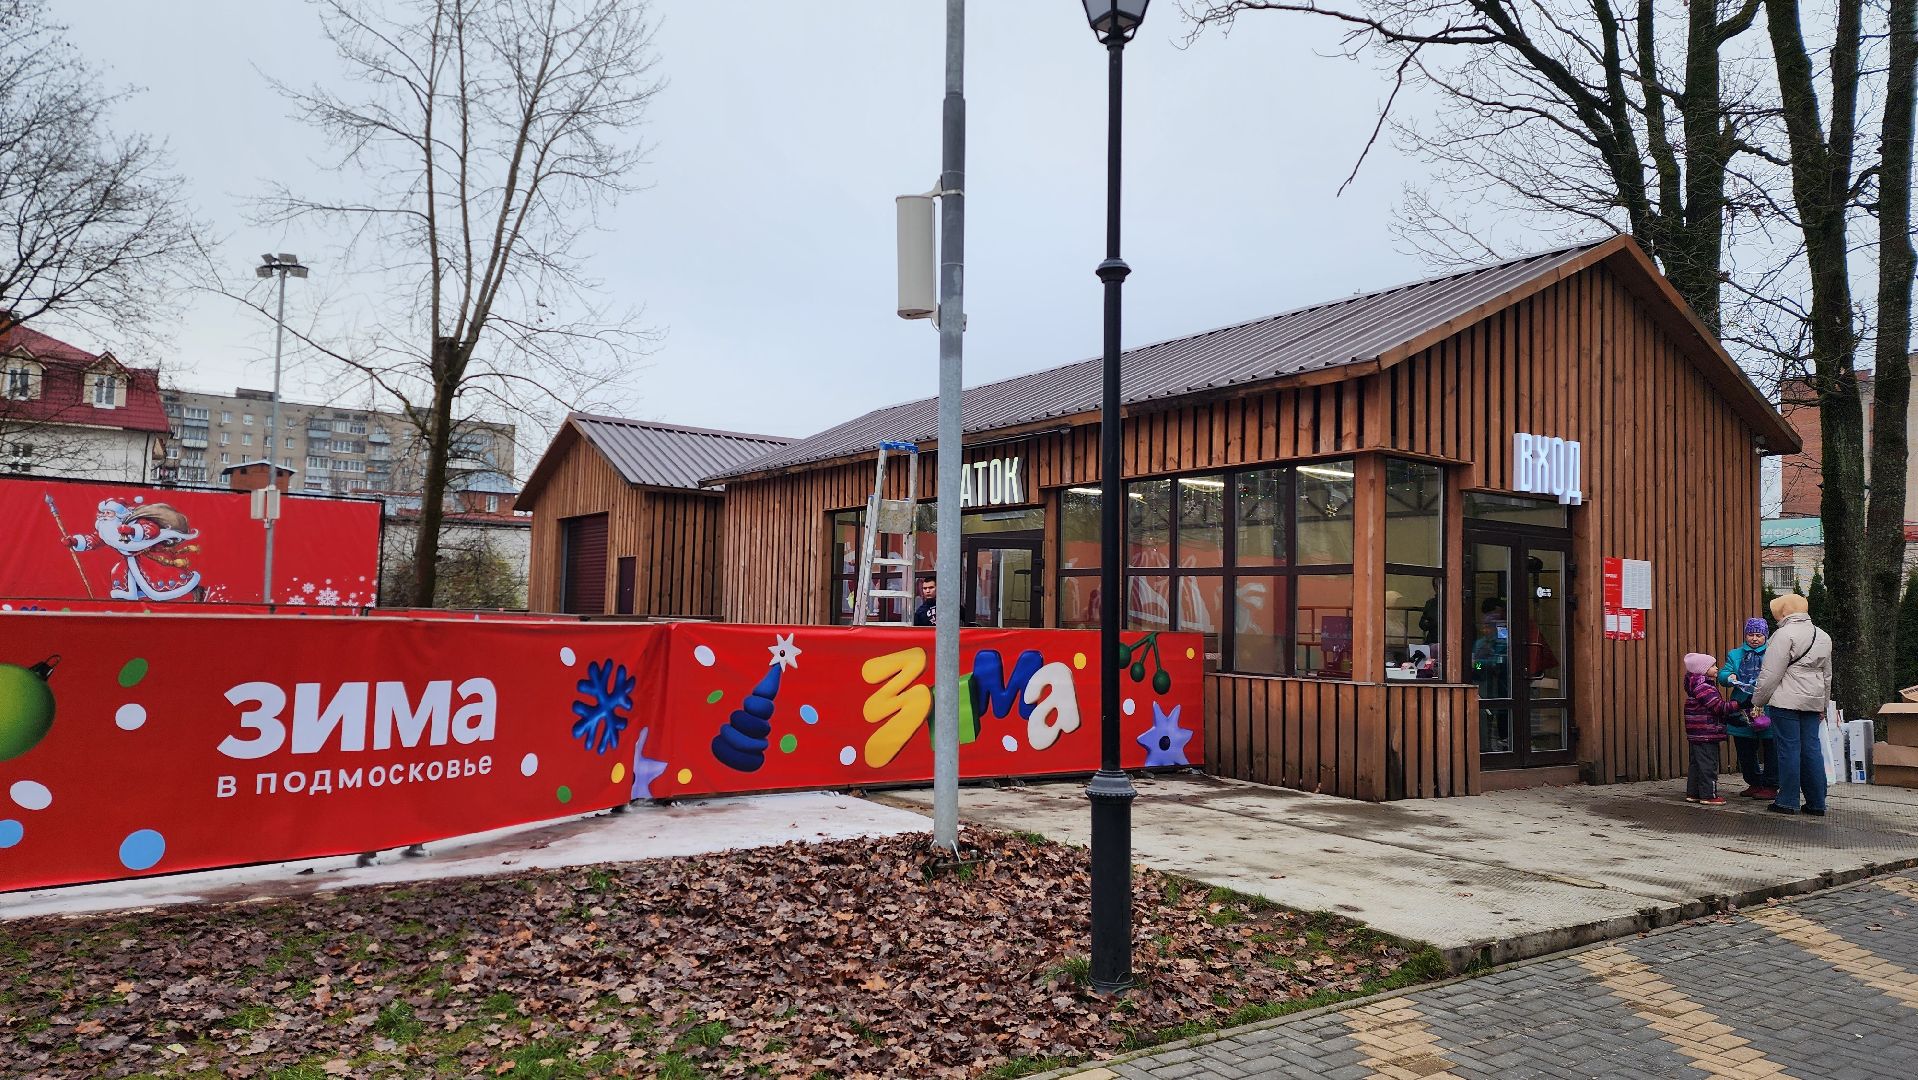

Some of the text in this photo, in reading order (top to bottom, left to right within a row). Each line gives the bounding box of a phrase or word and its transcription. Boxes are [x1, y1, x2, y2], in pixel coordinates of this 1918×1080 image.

[960, 456, 1024, 508] АТОК
[1513, 432, 1582, 506] ВХОД
[255, 755, 492, 796] подмосковье
